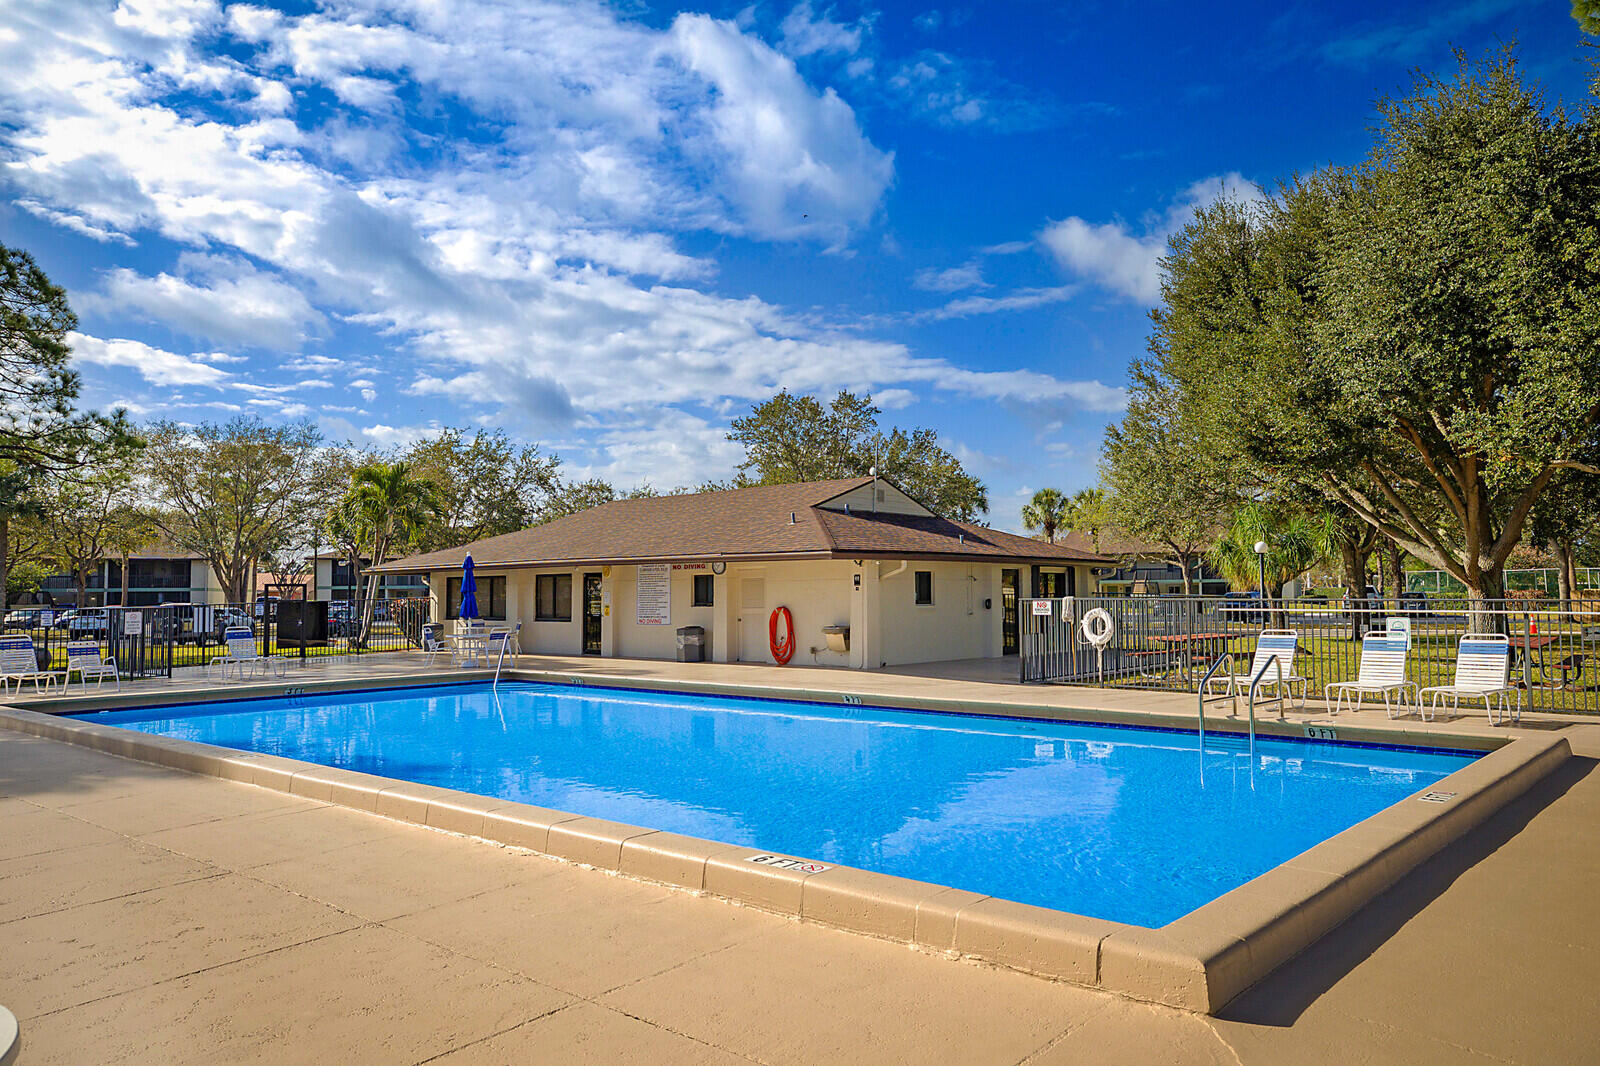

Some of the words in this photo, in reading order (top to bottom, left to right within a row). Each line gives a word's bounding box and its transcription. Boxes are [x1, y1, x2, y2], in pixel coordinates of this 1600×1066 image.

[1036, 600, 1047, 608] NO
[1319, 728, 1336, 739] FT
[768, 858, 805, 868] FT
